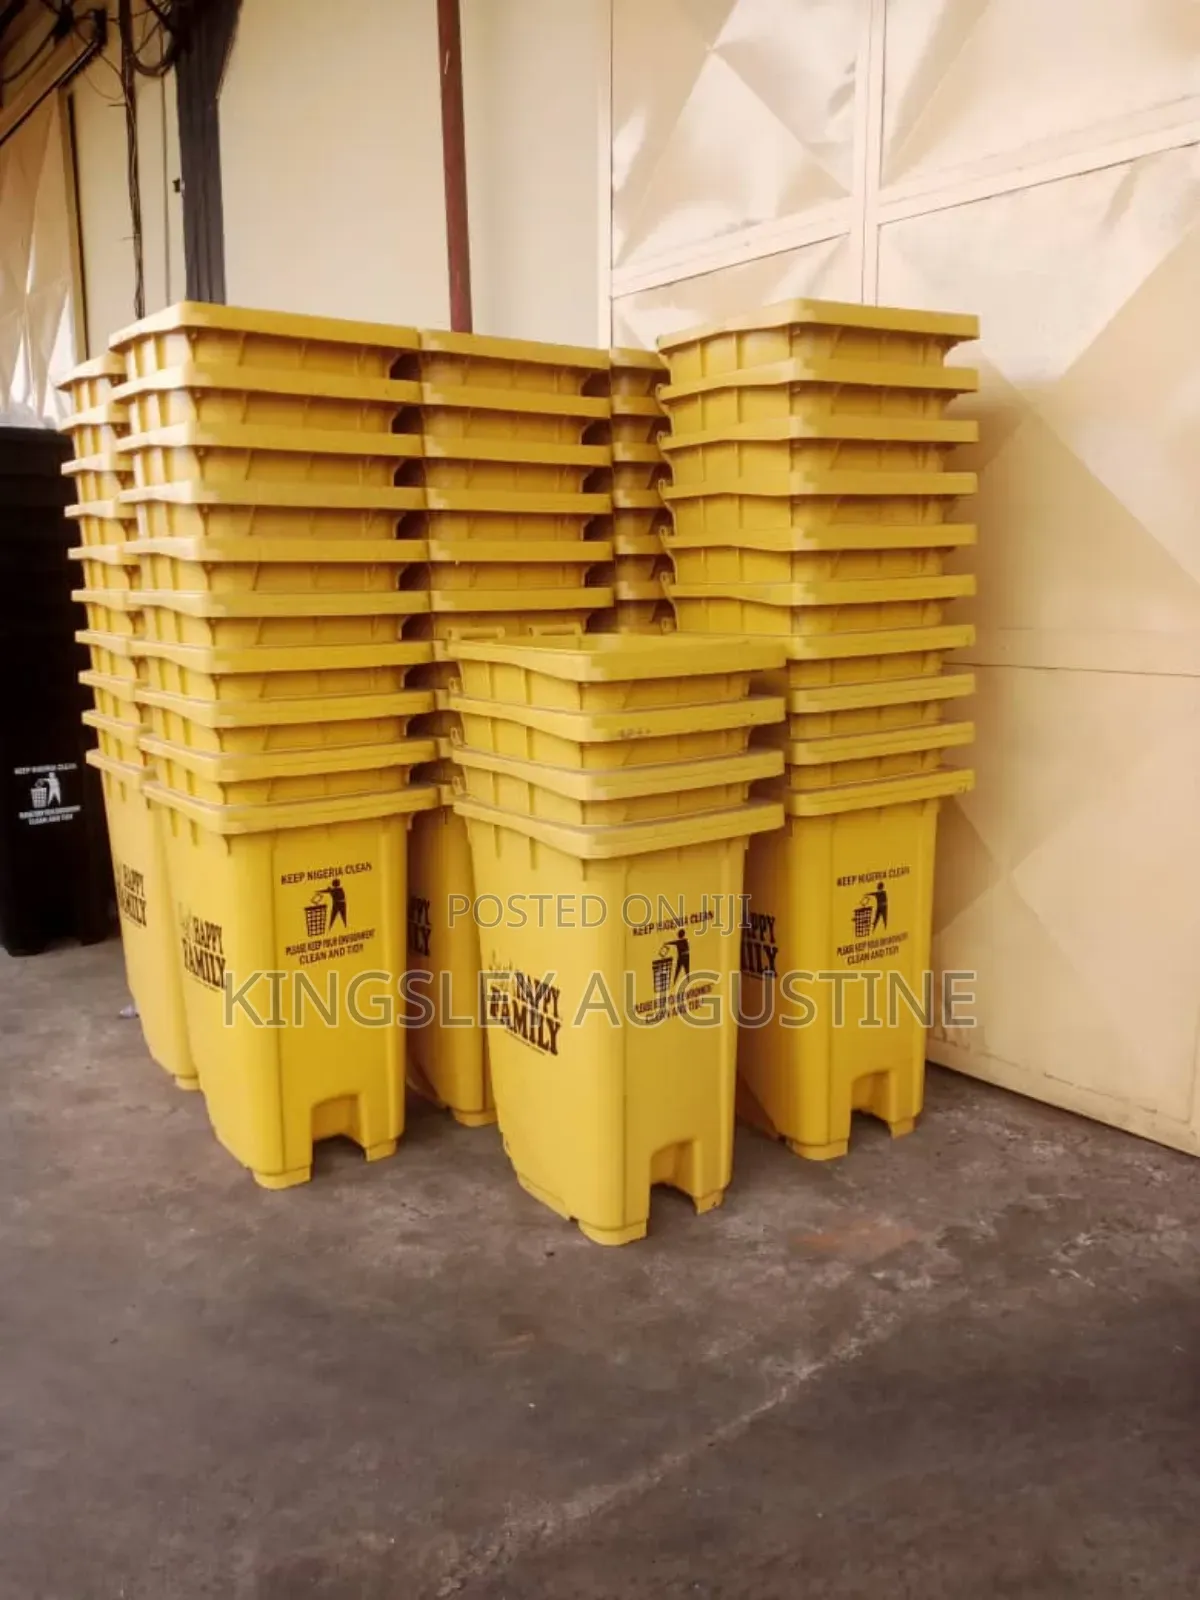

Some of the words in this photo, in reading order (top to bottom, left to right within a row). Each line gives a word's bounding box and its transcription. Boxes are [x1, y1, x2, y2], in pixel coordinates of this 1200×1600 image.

[281, 872, 305, 885] KEEP
[307, 866, 343, 881] NIGERIA
[345, 861, 373, 875] CLEAN
[837, 876, 856, 887] KEEP
[888, 866, 911, 878] CLEAN
[192, 916, 224, 956] HAPPY
[633, 923, 654, 936] KEEP
[690, 910, 715, 924] CLEAN
[182, 938, 226, 989] FAMILY
[300, 952, 327, 965] CLEAN
[328, 947, 346, 960] AND
[348, 944, 364, 955] TIDY
[847, 953, 870, 966] CLEAN
[512, 969, 561, 1020] HAPPY
[489, 983, 561, 1057] FAMILY
